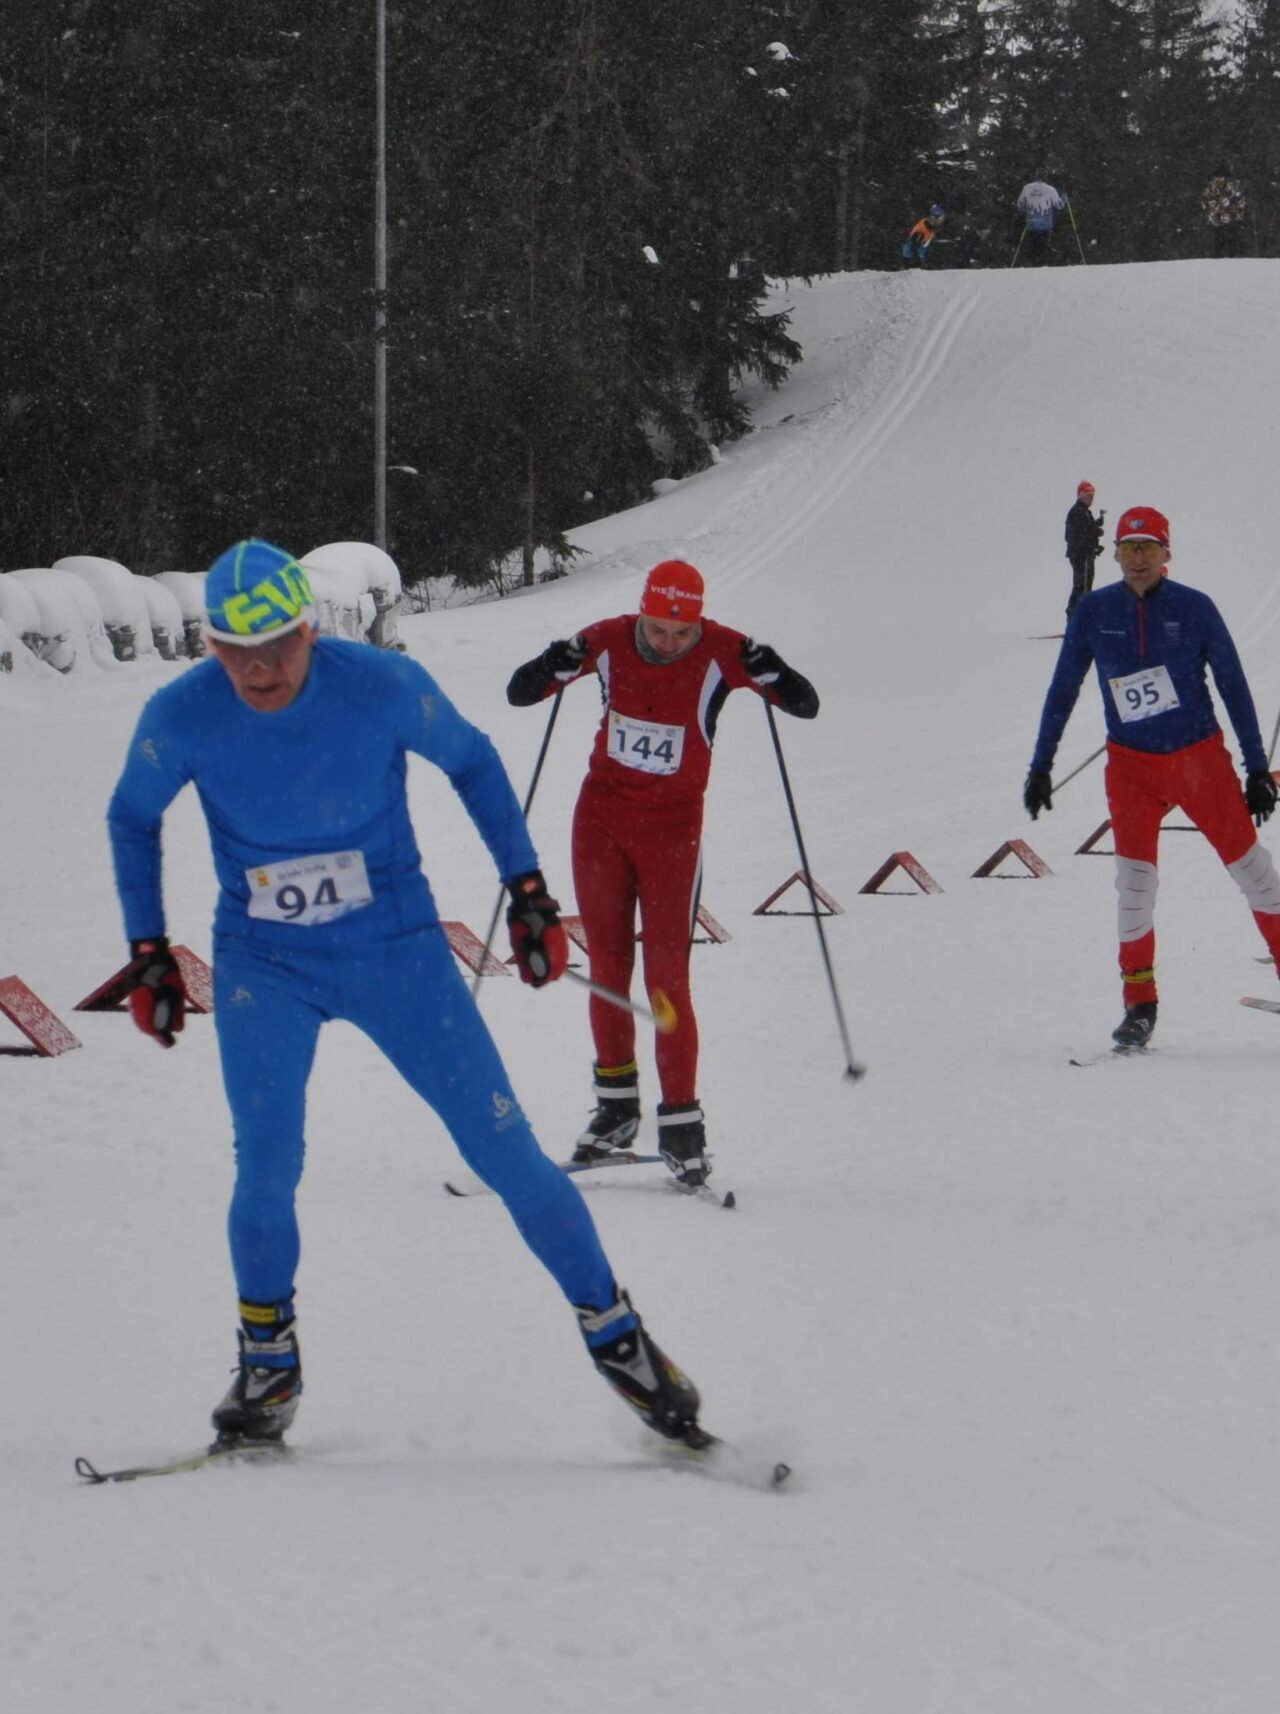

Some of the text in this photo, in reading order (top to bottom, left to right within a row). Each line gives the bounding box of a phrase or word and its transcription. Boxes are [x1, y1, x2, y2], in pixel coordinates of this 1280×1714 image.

[1125, 681, 1160, 710] 95
[616, 728, 674, 764] 144
[275, 877, 344, 920] 94
